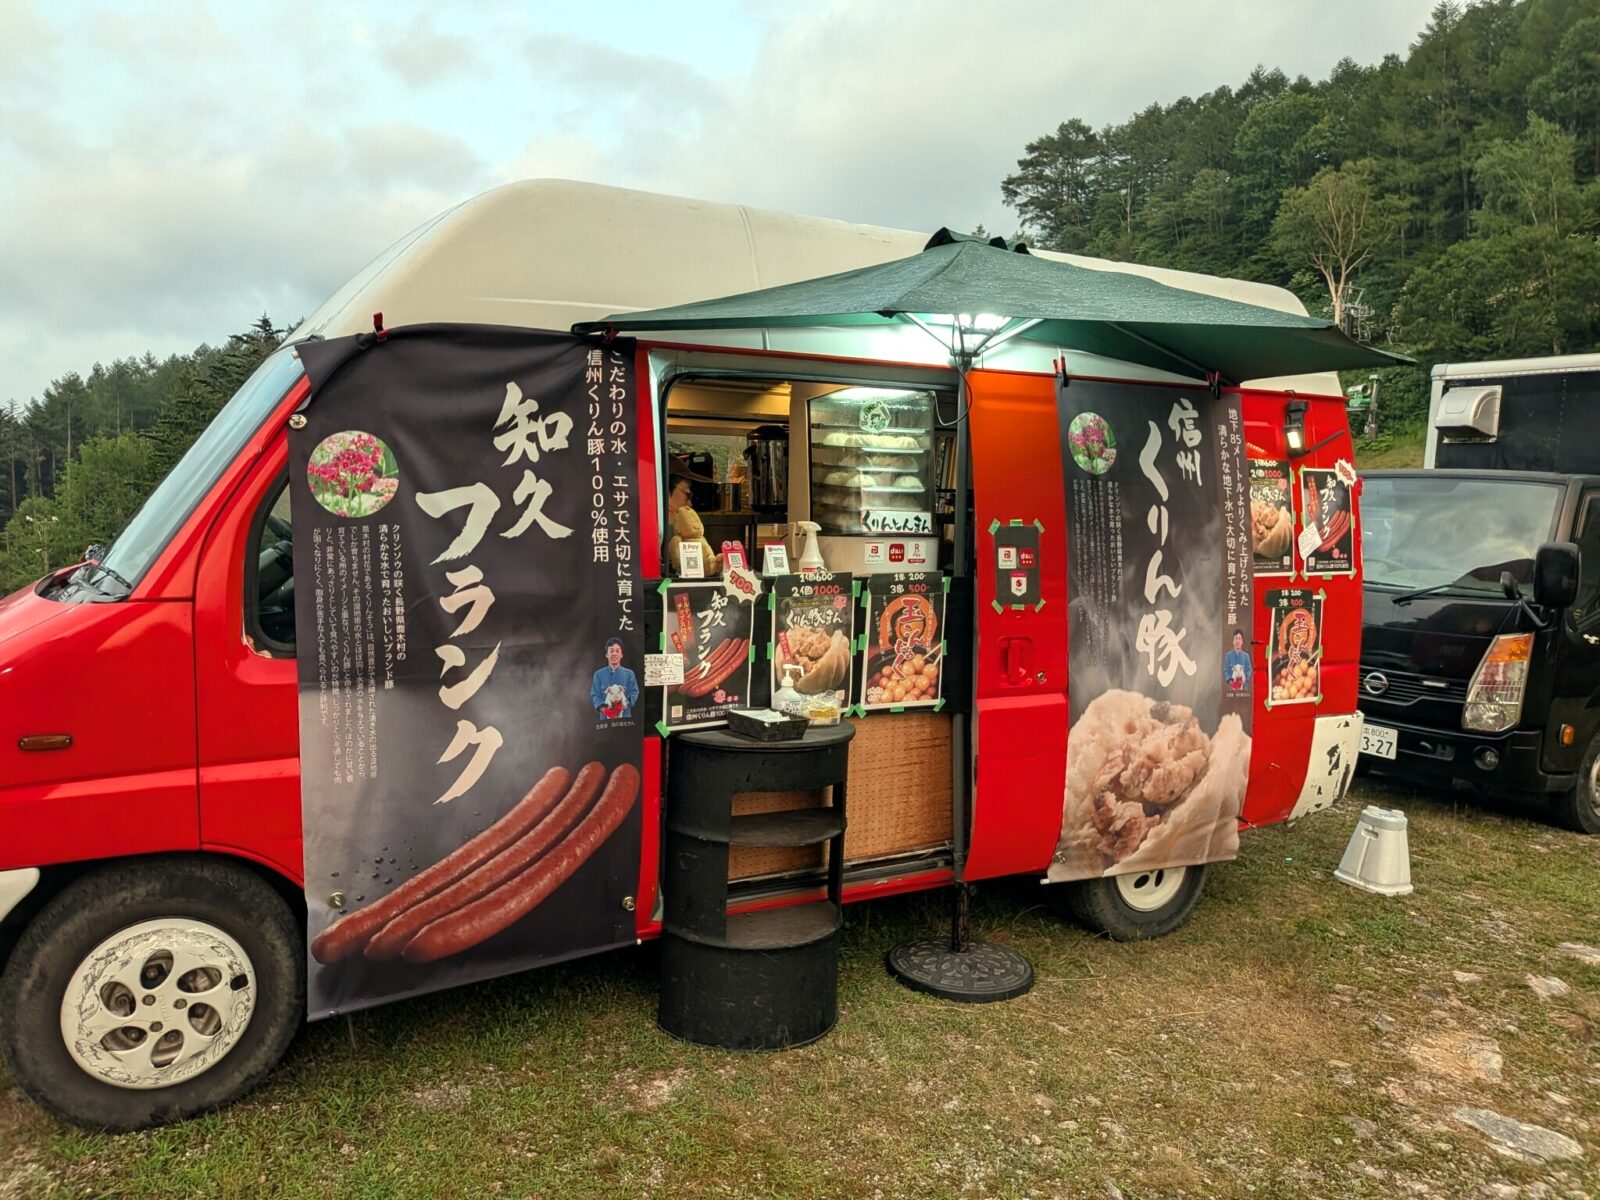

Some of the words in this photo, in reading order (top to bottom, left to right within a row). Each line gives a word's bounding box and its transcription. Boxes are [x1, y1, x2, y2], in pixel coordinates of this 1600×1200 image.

[492, 381, 576, 539] 知久
[585, 349, 609, 562] 信州くりん豚100%使用
[609, 350, 634, 631] こだわりの水・エサで大切に育てた
[1168, 398, 1202, 486] 信州
[863, 510, 932, 532] くりんとんまん
[1135, 420, 1198, 687] くりん豚
[1228, 408, 1249, 606] 地下85メートルよりくみ上げられた
[415, 482, 504, 805] フランク
[697, 609, 715, 679] フランク
[711, 590, 729, 627] 知久
[785, 608, 843, 630] くりん豚まん
[1362, 736, 1393, 756] 3-27
